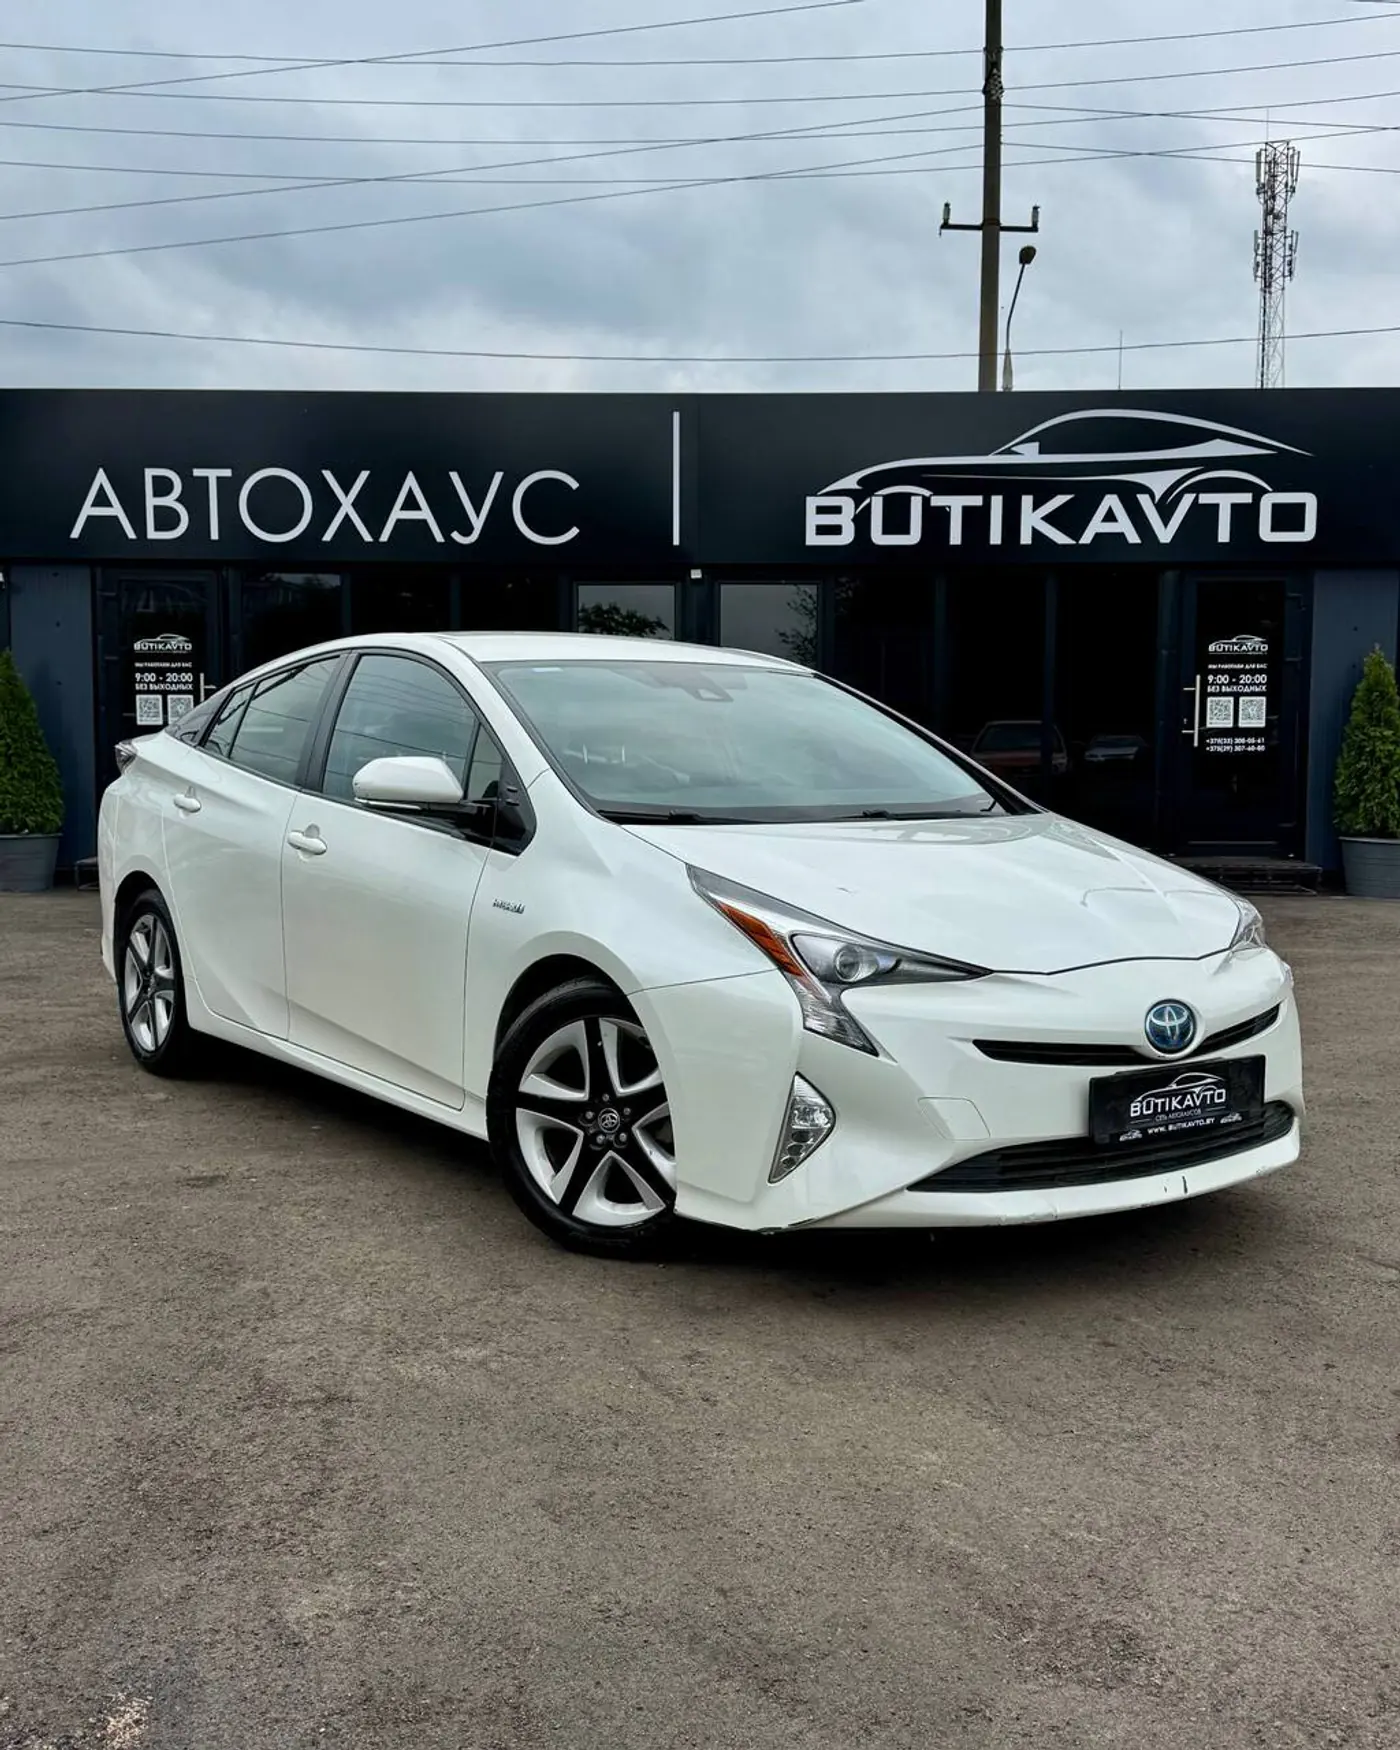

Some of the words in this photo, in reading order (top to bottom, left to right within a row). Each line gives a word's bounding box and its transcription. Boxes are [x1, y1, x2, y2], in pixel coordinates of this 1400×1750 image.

[70, 467, 580, 545] АВТОХАУС
[805, 492, 1317, 546] BUTIKAVTO
[1208, 643, 1268, 651] BUTIKAVTO
[135, 672, 156, 683] 9:00
[165, 672, 193, 683] 20:00
[1207, 674, 1229, 684] 9:00
[1239, 674, 1267, 684] 20:00
[1207, 685, 1220, 693] БЕЗ
[1221, 685, 1267, 693] ВЫХОДНЫХ
[1130, 1088, 1227, 1117] BUTIKAVTO
